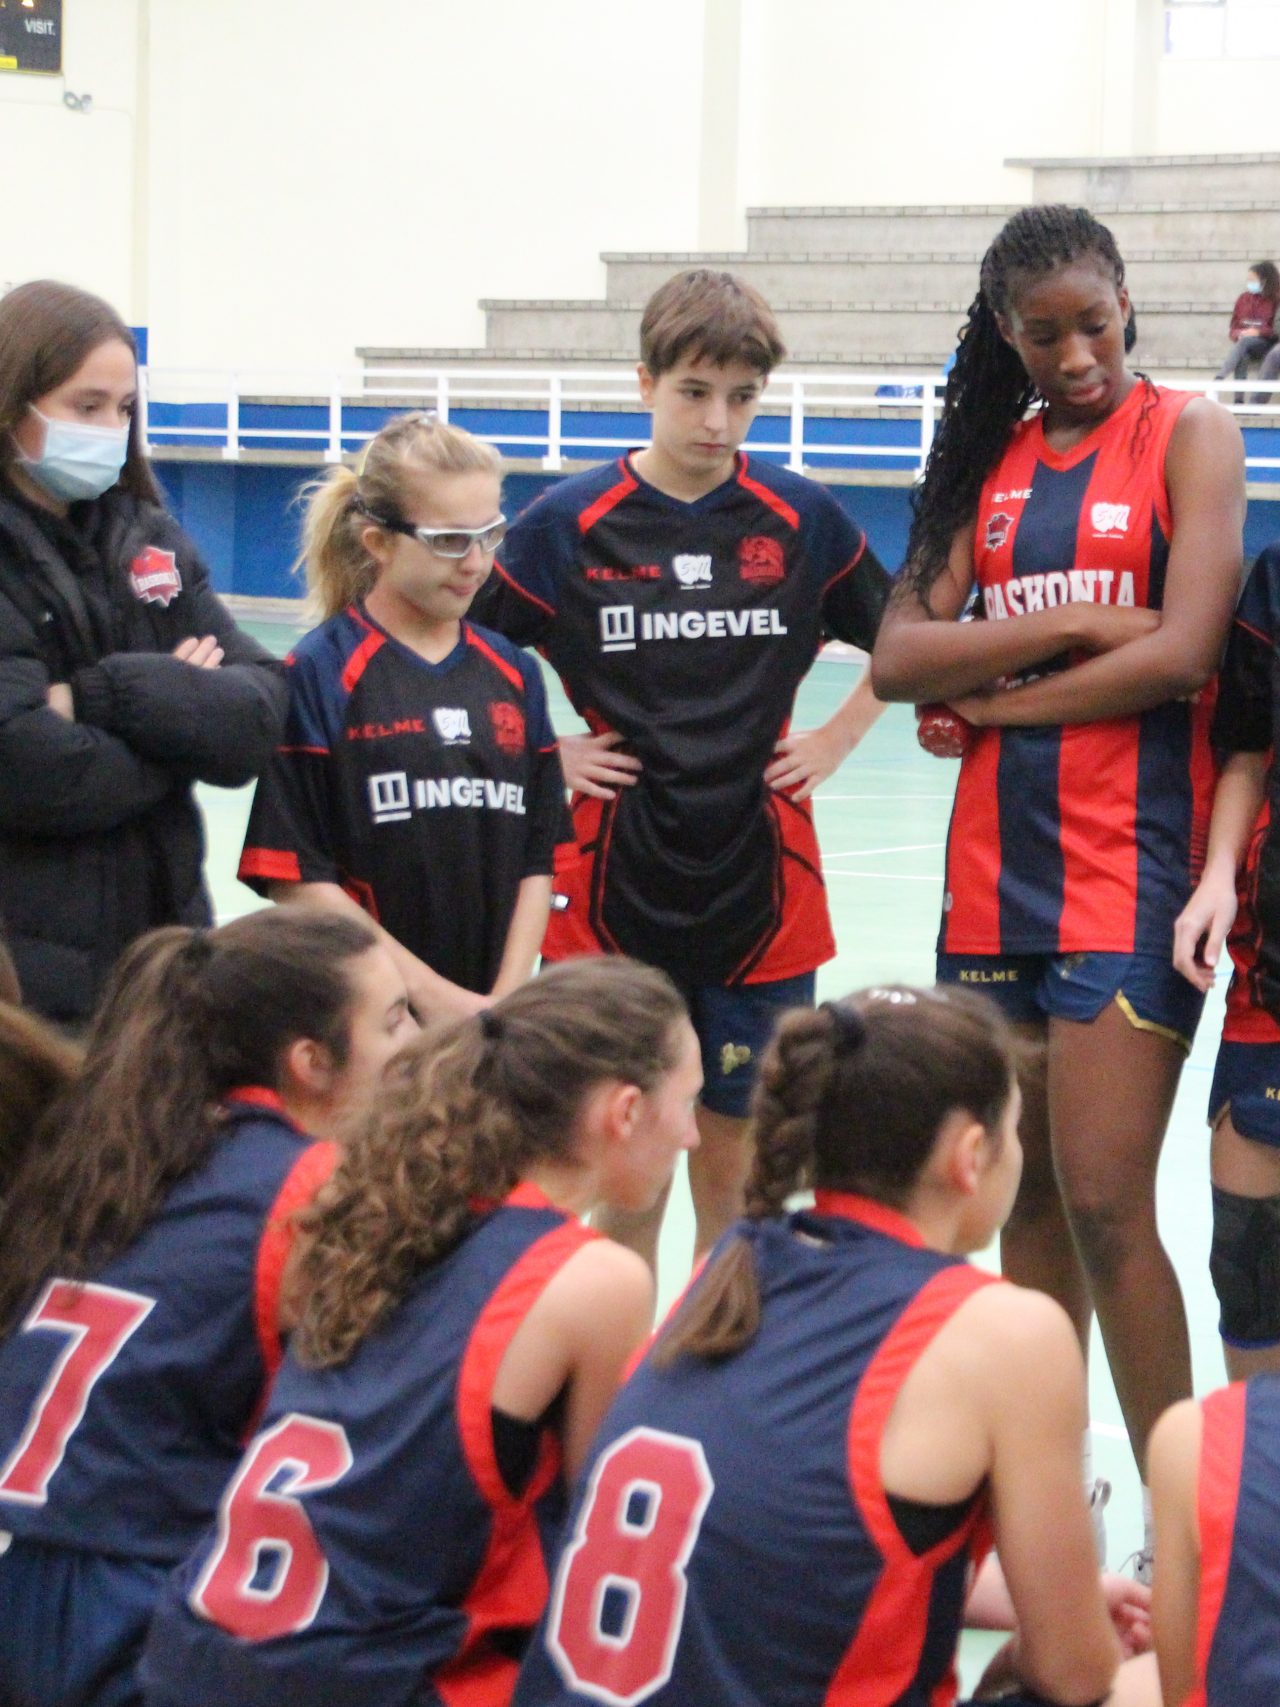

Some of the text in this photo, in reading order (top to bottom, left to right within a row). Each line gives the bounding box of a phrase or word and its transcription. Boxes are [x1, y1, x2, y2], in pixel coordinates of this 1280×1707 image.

[24, 18, 56, 36] VISIT.
[641, 608, 788, 641] INGEVEL
[347, 719, 426, 741] KELME
[414, 776, 527, 815] INGEVEL
[959, 968, 1019, 983] KELME
[0, 1278, 156, 1504] 7
[190, 1412, 354, 1643] 6
[547, 1425, 715, 1704] 8
